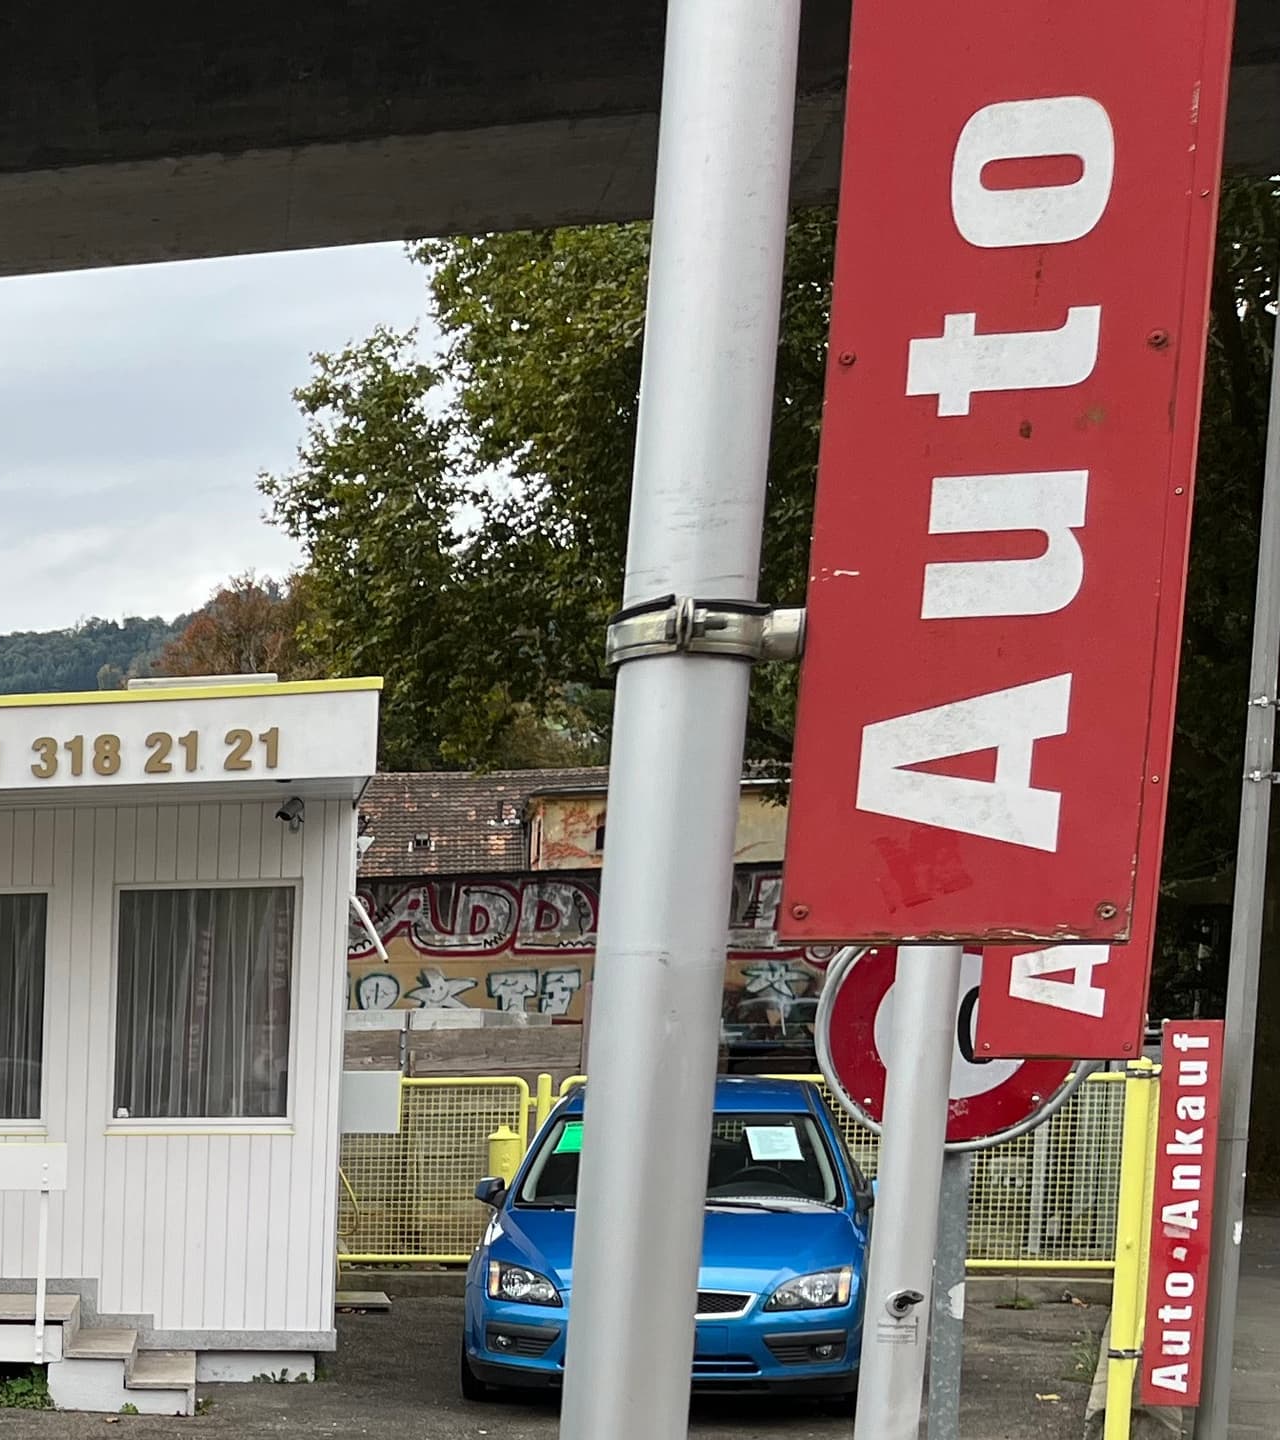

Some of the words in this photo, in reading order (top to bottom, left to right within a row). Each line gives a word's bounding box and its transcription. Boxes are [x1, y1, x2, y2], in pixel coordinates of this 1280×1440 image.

[855, 95, 1116, 853] Auto
[31, 734, 122, 778] 318
[145, 730, 198, 774] 21
[224, 727, 279, 770] 21
